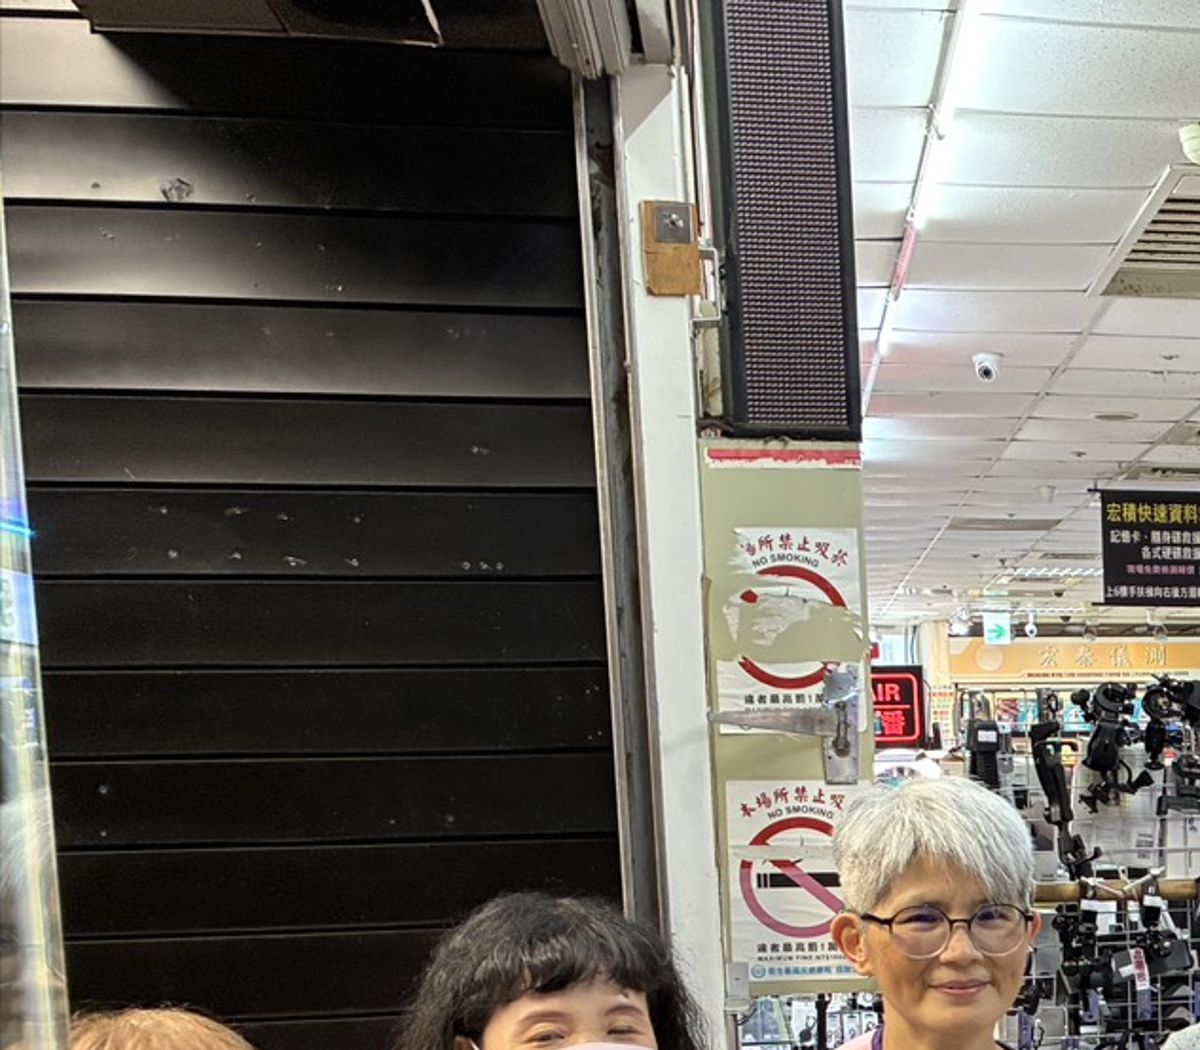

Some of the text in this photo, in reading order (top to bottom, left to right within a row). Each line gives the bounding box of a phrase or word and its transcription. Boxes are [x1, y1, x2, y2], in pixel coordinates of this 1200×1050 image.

[752, 552, 821, 569] NO SMOKING
[767, 804, 835, 820] NO SMOKING
